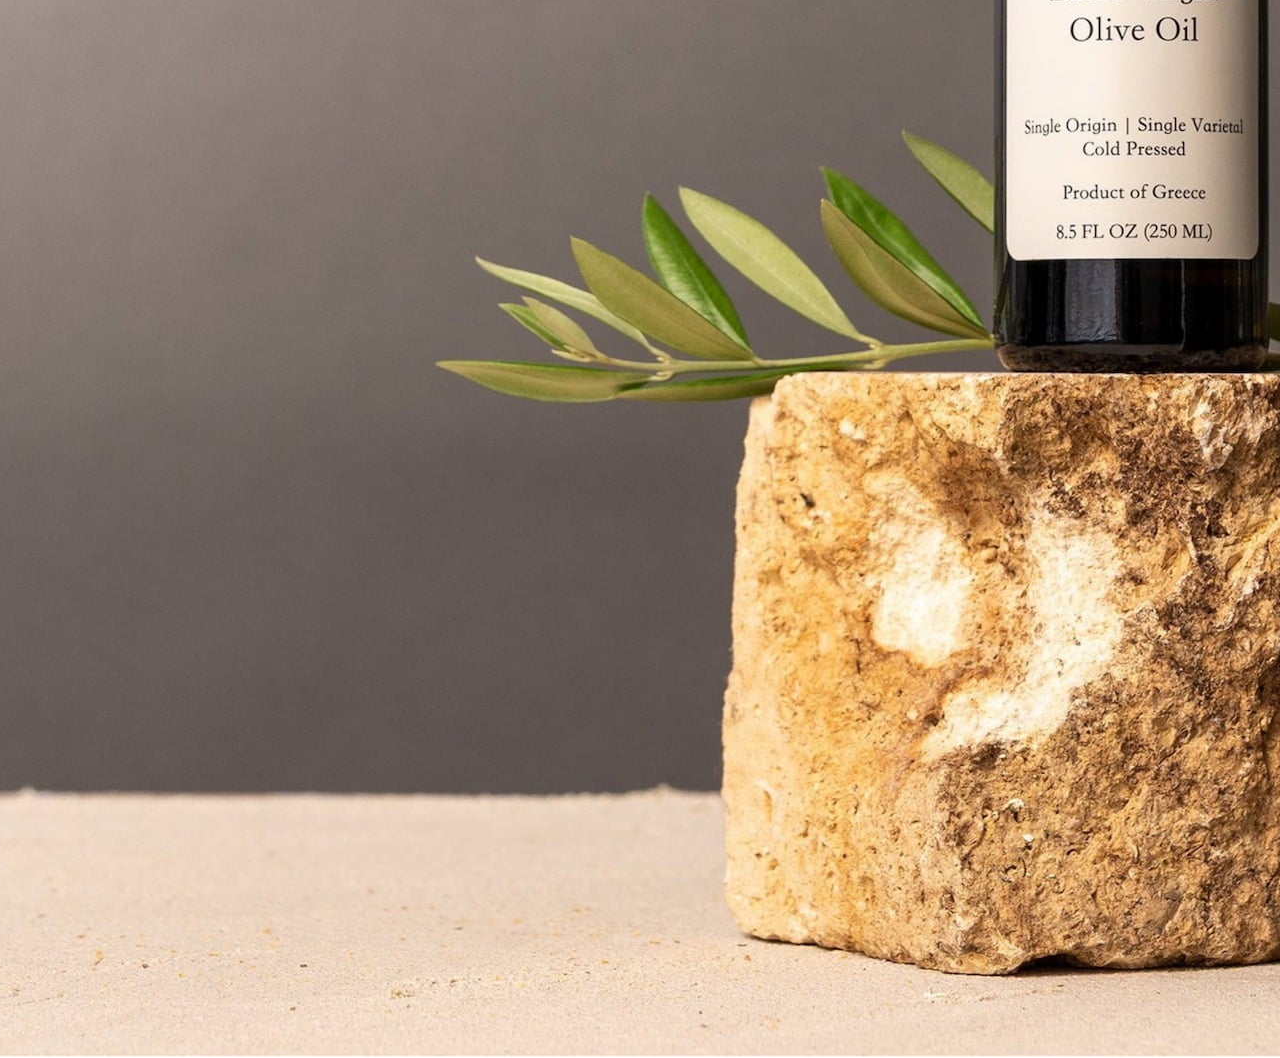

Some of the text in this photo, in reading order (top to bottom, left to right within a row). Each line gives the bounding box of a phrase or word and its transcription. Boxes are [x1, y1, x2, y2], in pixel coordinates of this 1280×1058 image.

[1070, 16, 1198, 42] Olive Oil
[1025, 118, 1061, 136] Single
[1066, 118, 1117, 134] Origin
[1138, 117, 1186, 134] Single
[1191, 118, 1243, 134] Varietal
[1083, 141, 1185, 156] Cold Pressed
[1064, 184, 1206, 199] Product of Greece
[1057, 223, 1212, 242] 8.5 FL OZ (250 ML)
